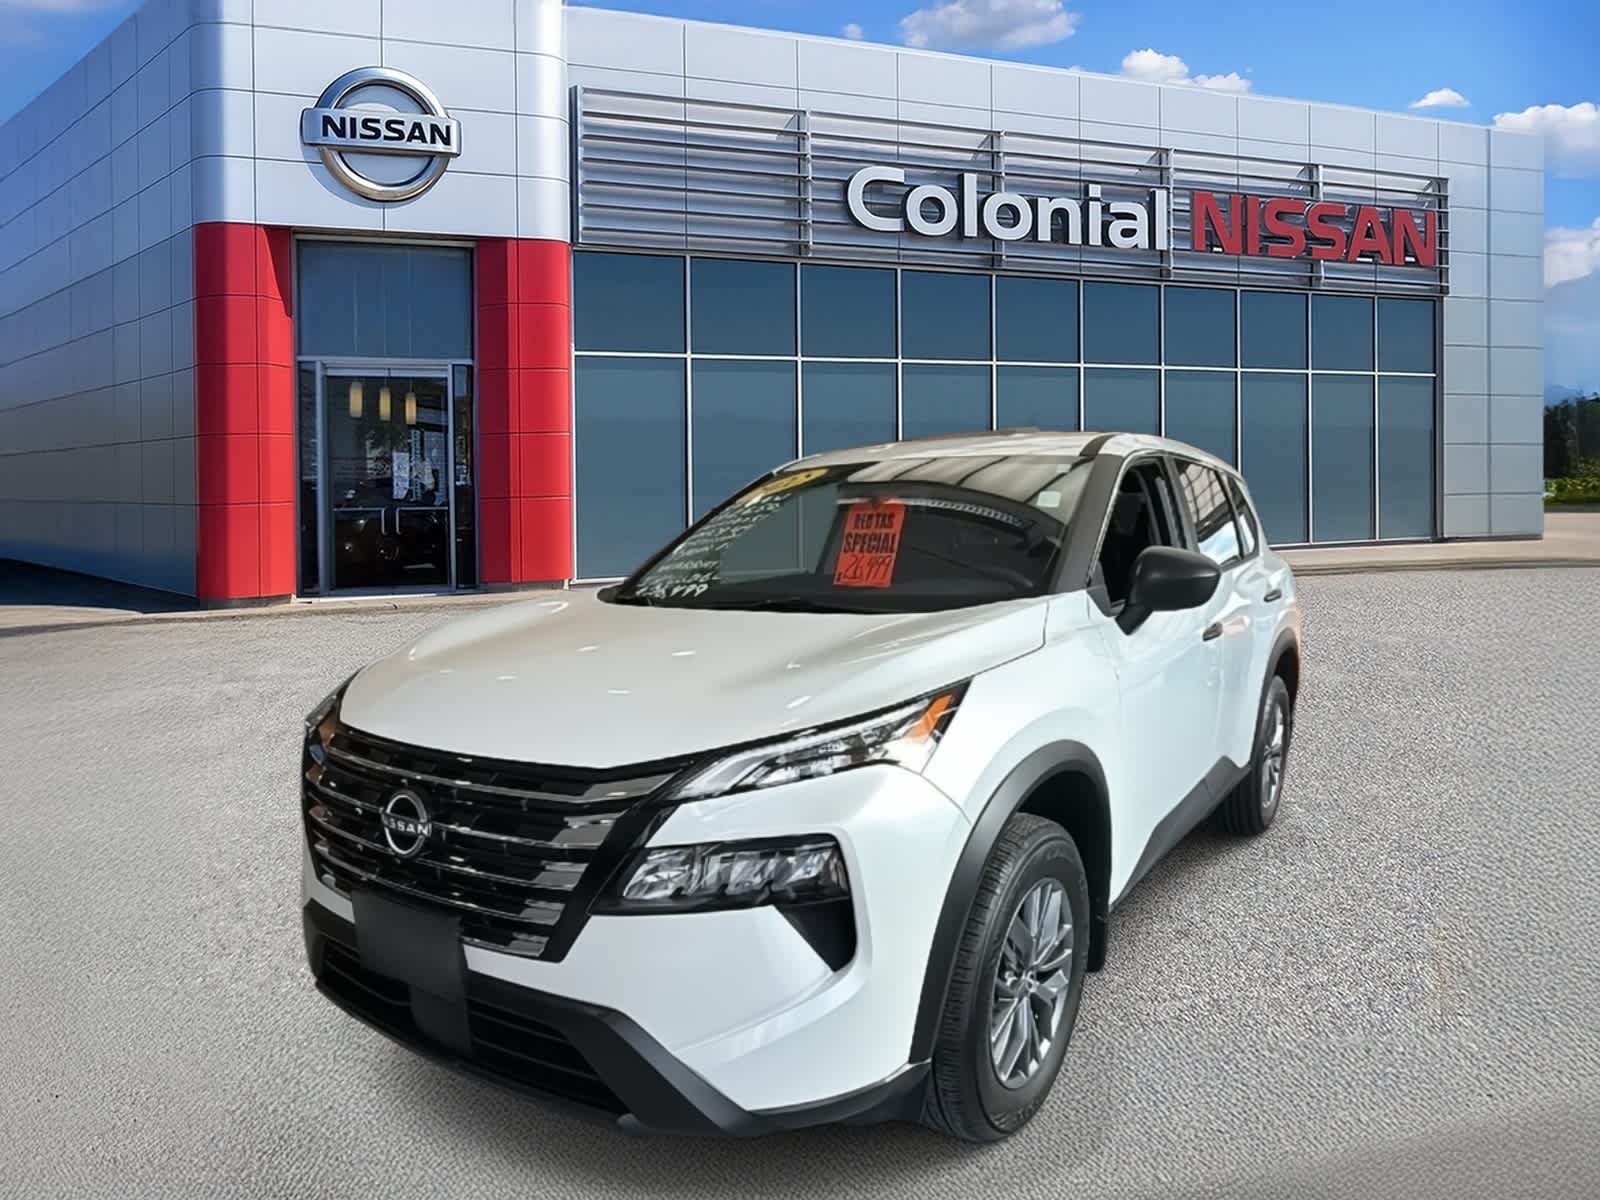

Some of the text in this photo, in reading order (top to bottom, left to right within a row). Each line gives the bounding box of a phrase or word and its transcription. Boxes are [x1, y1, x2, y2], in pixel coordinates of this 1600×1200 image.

[322, 115, 451, 146] NISSAN
[847, 165, 1437, 267] Colonial NISSAN
[844, 532, 897, 554] SPECIAL
